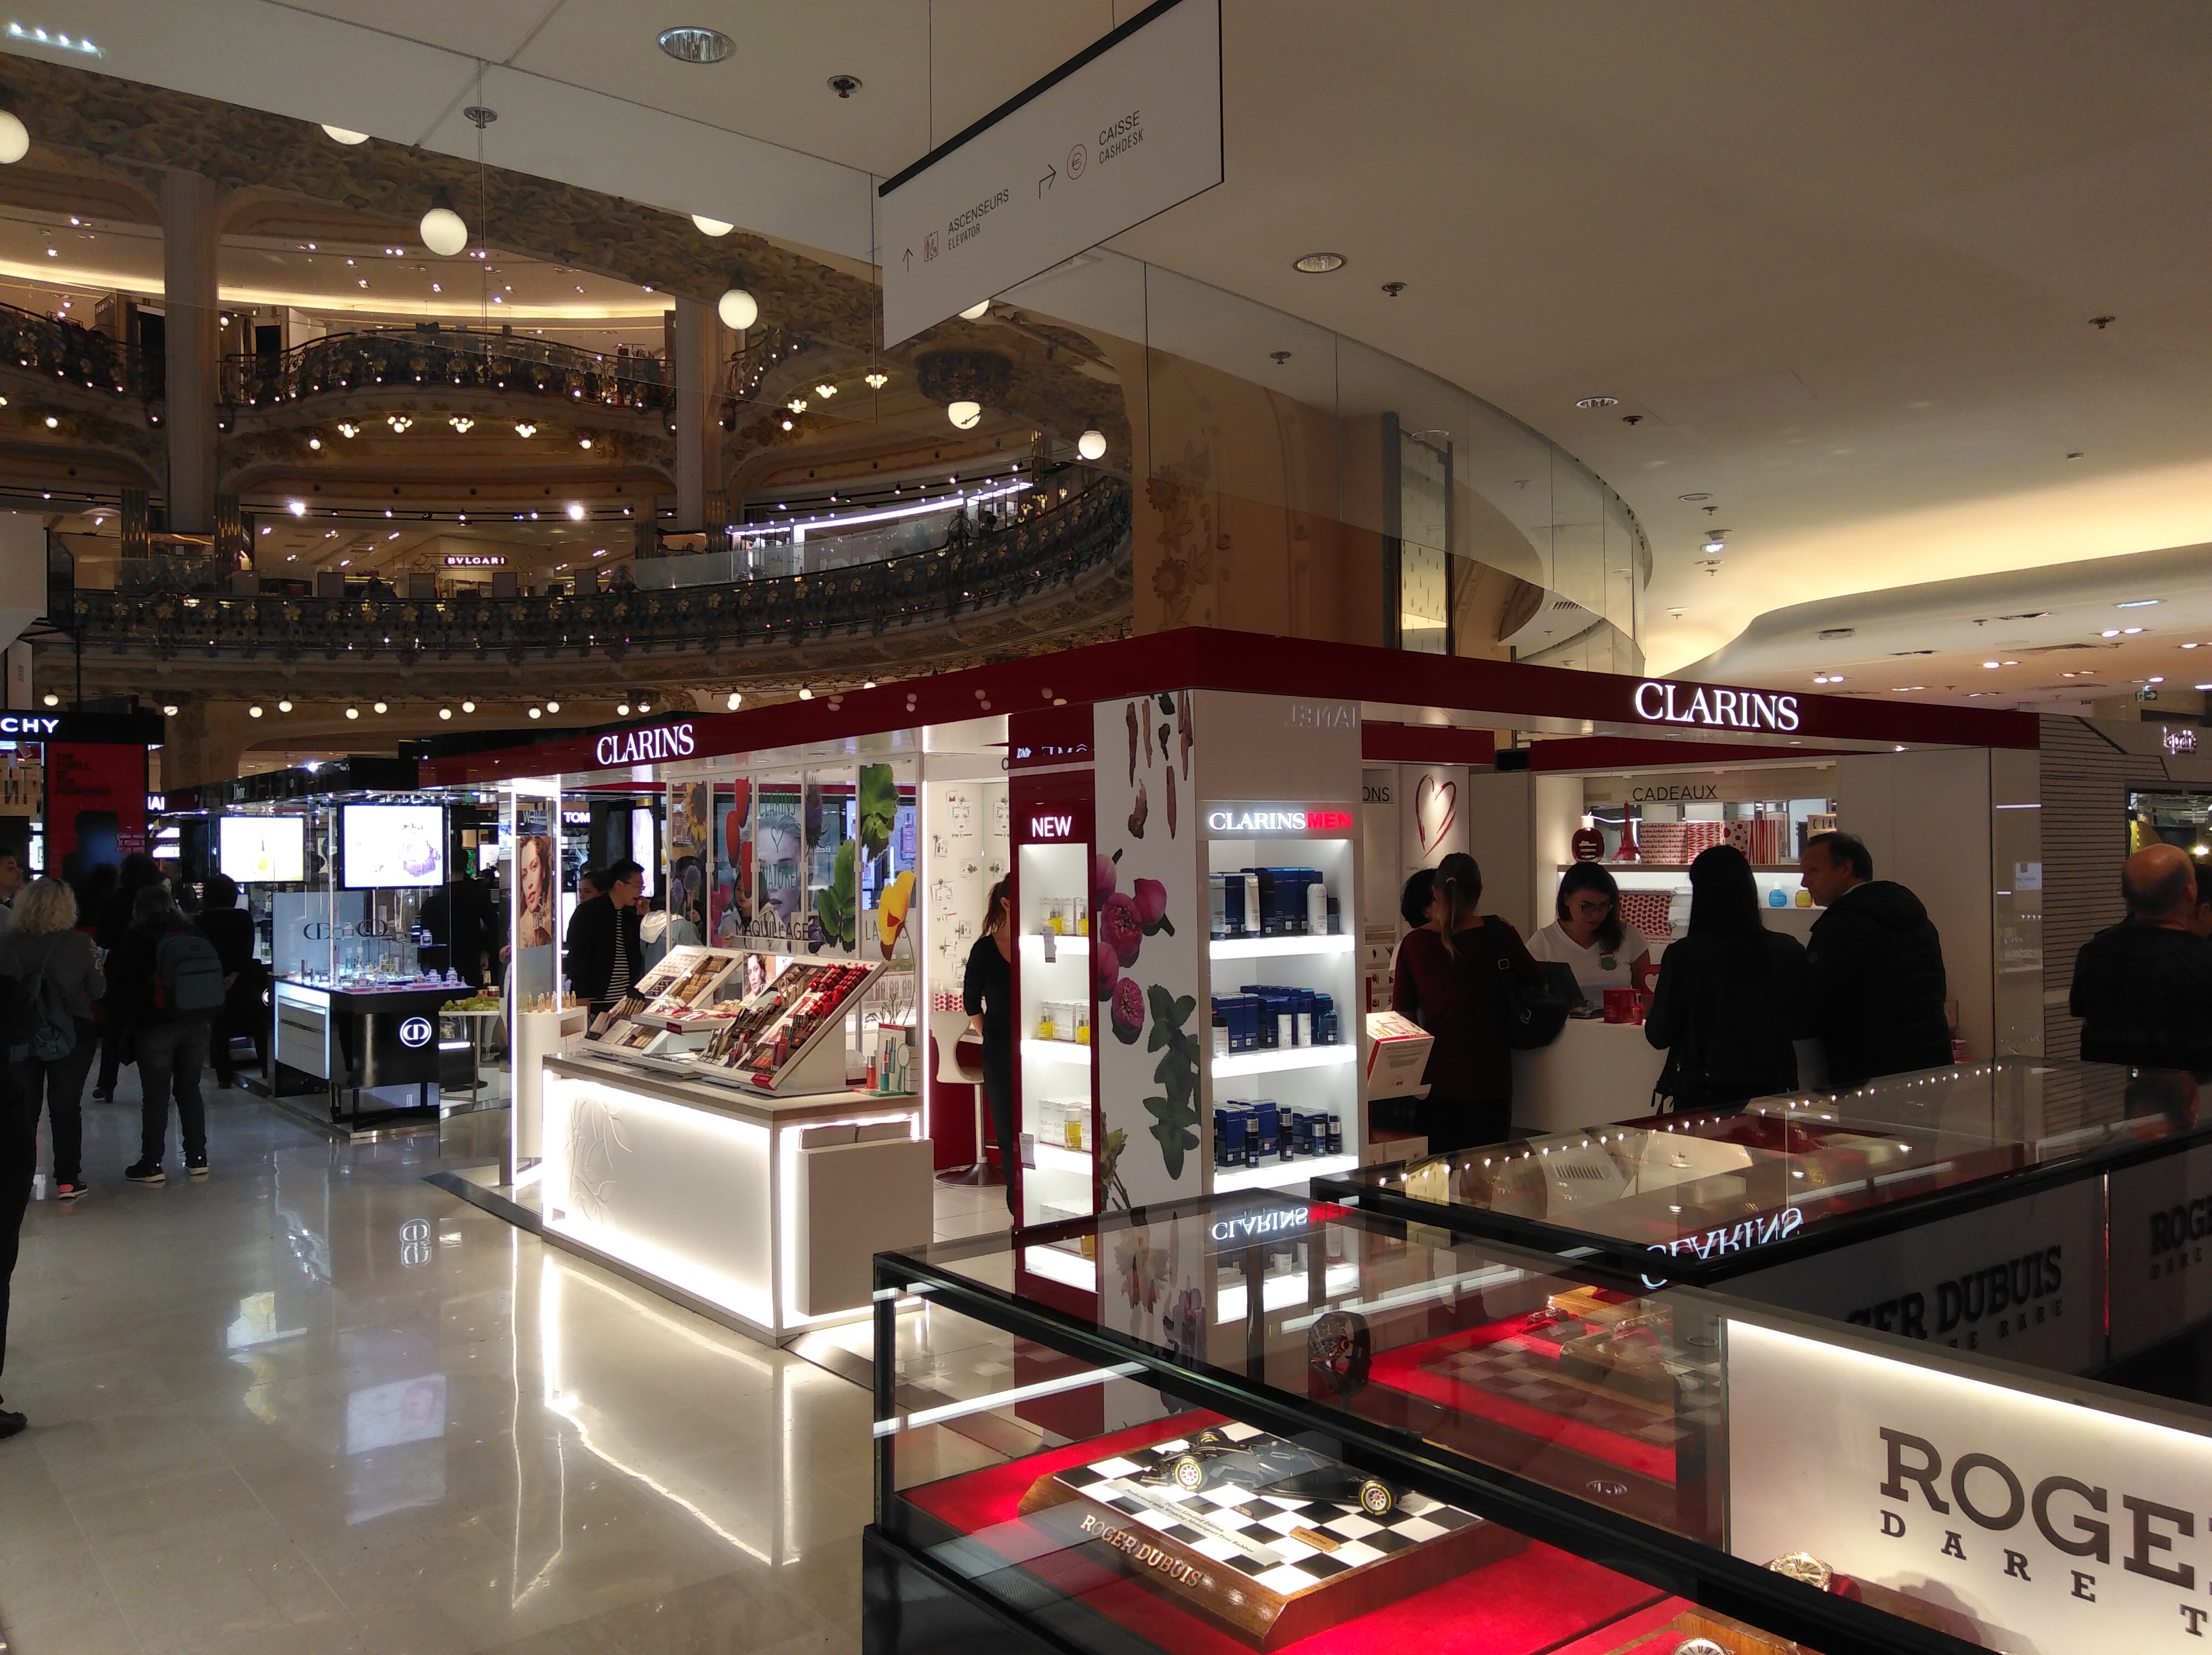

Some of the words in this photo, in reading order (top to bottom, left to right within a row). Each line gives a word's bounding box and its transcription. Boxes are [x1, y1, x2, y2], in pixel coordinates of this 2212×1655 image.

[1099, 110, 1140, 146] CAISSE
[1099, 128, 1144, 164] CASHDESK
[948, 189, 1009, 235] ASCENSEURS
[948, 223, 981, 251] ELEVATOR
[1635, 682, 1799, 730] CLARINS
[0, 717, 59, 733] CHY
[596, 724, 695, 764] CLARINS
[233, 783, 246, 800] Dior
[1633, 785, 1718, 801] CADEAUX
[1032, 815, 1072, 838] NEW
[735, 919, 810, 941] MAQUILLAGE
[1936, 1245, 2063, 1333] DUBUIS
[1999, 1299, 2063, 1338] RARE
[1125, 1489, 1154, 1504] Performed
[1164, 1507, 1187, 1521] Winning
[1187, 1518, 1219, 1536] Motorsport
[1218, 1533, 1232, 1543] Tyre
[1231, 1540, 1255, 1553] Rubber
[1182, 1510, 1204, 1522] Limited
[1204, 1521, 1224, 1533] Edition
[1880, 1426, 2212, 1591] ROGE
[1080, 1514, 1137, 1554] ROGER
[1135, 1542, 1203, 1588] DUBUIS
[1880, 1509, 2096, 1603] DARE
